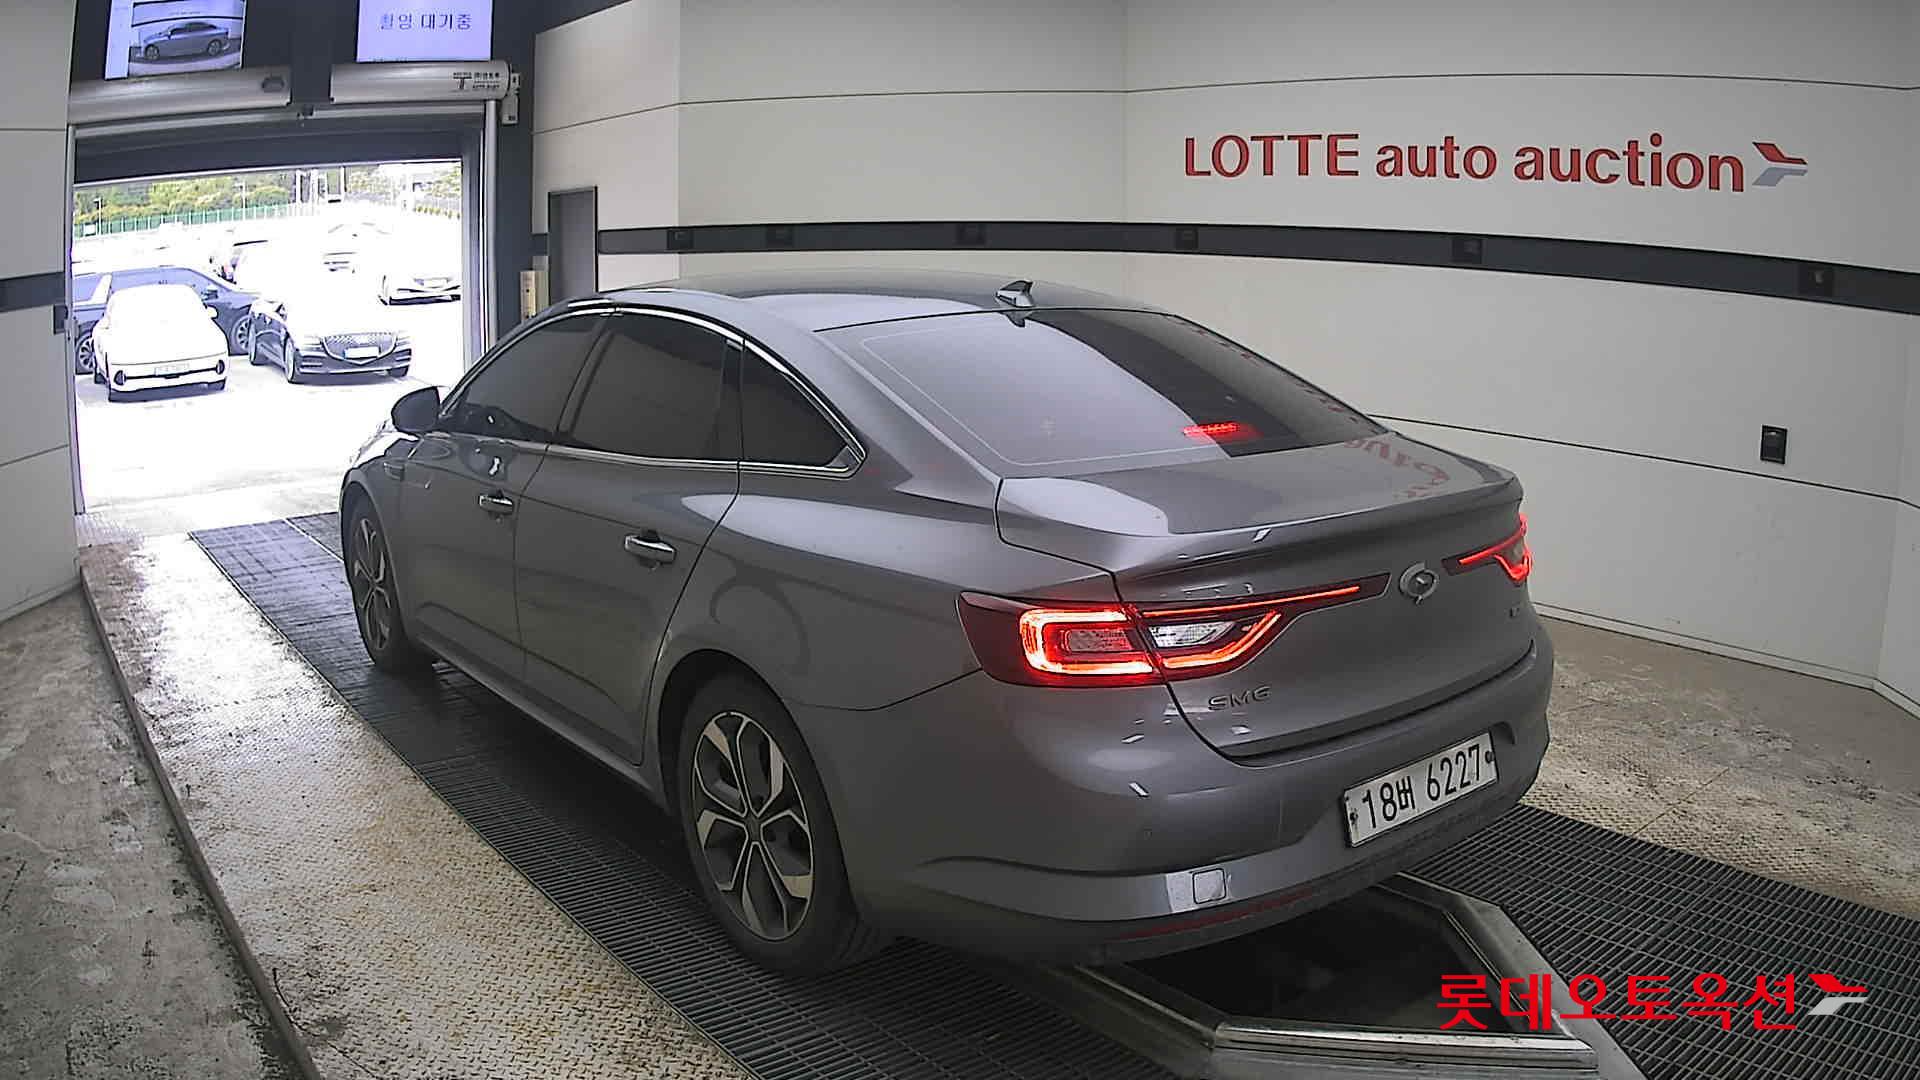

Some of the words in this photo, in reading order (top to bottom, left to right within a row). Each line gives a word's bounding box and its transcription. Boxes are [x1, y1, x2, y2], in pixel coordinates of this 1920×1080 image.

[421, 13, 471, 30] 대기중
[1185, 133, 1359, 178] LOTTE
[1375, 136, 1497, 180] auto
[1513, 132, 1744, 192] auction
[1362, 775, 1415, 828] 18버
[1427, 744, 1480, 801] 6227
